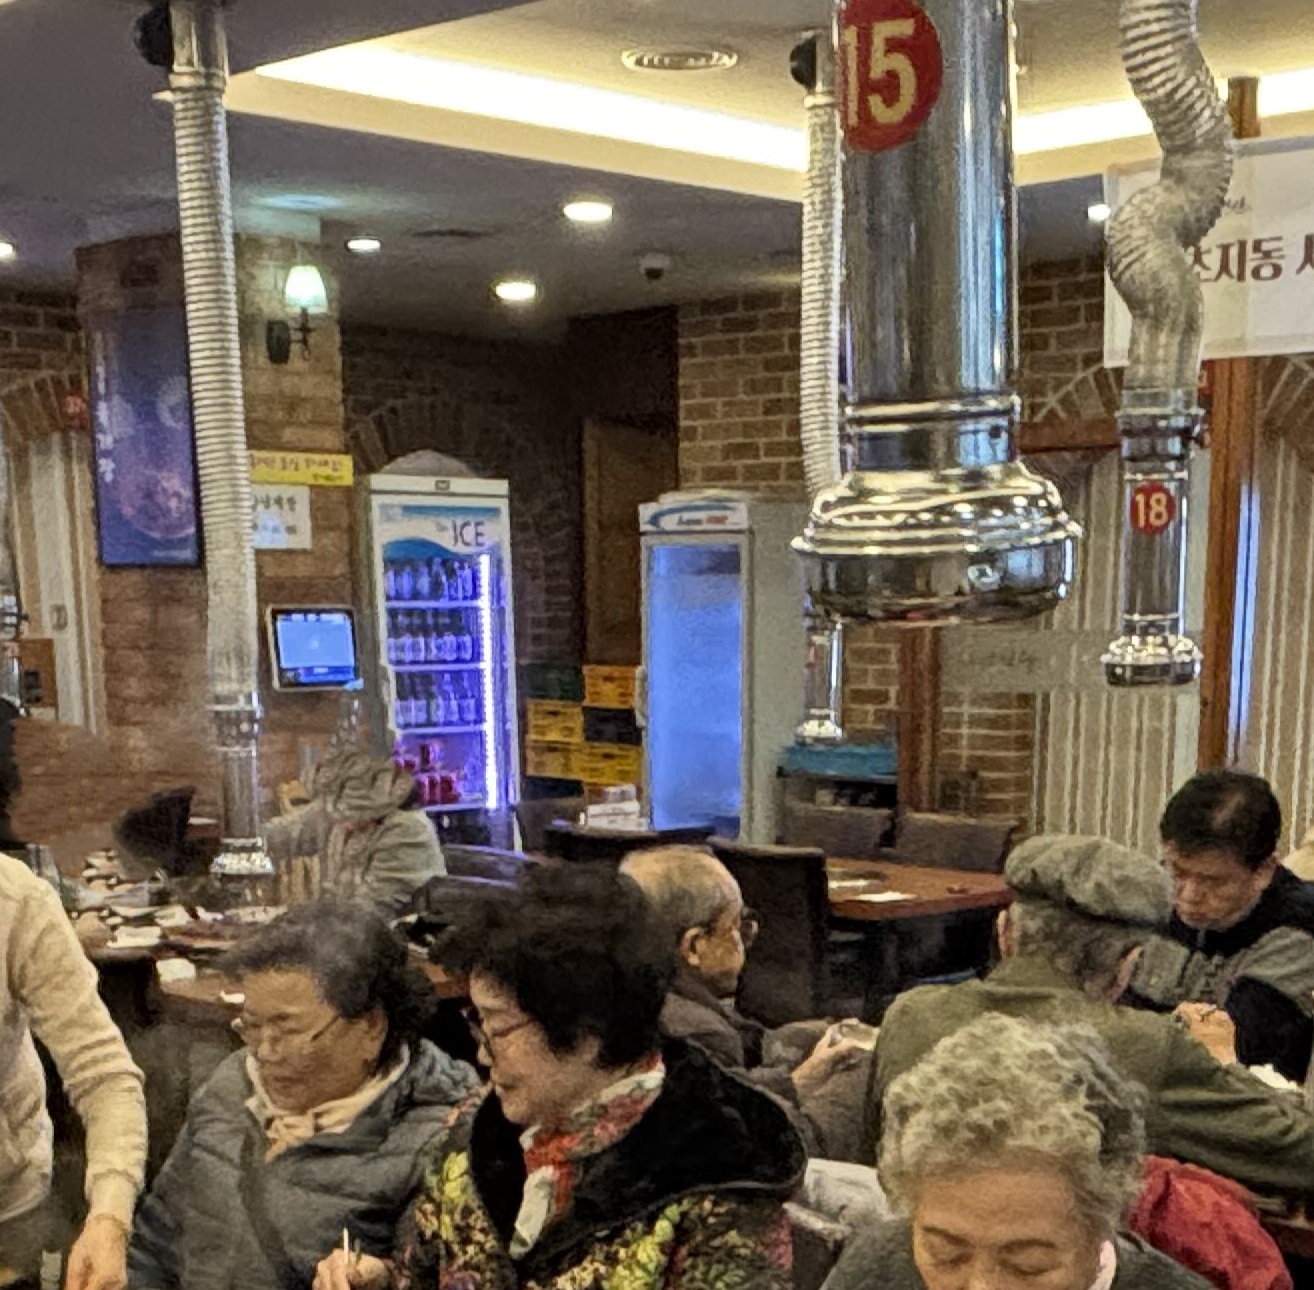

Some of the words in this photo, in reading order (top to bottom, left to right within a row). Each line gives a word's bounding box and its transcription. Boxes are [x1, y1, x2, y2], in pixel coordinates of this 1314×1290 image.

[843, 18, 917, 127] 15
[1135, 492, 1169, 528] 18
[452, 520, 487, 547] ICE
